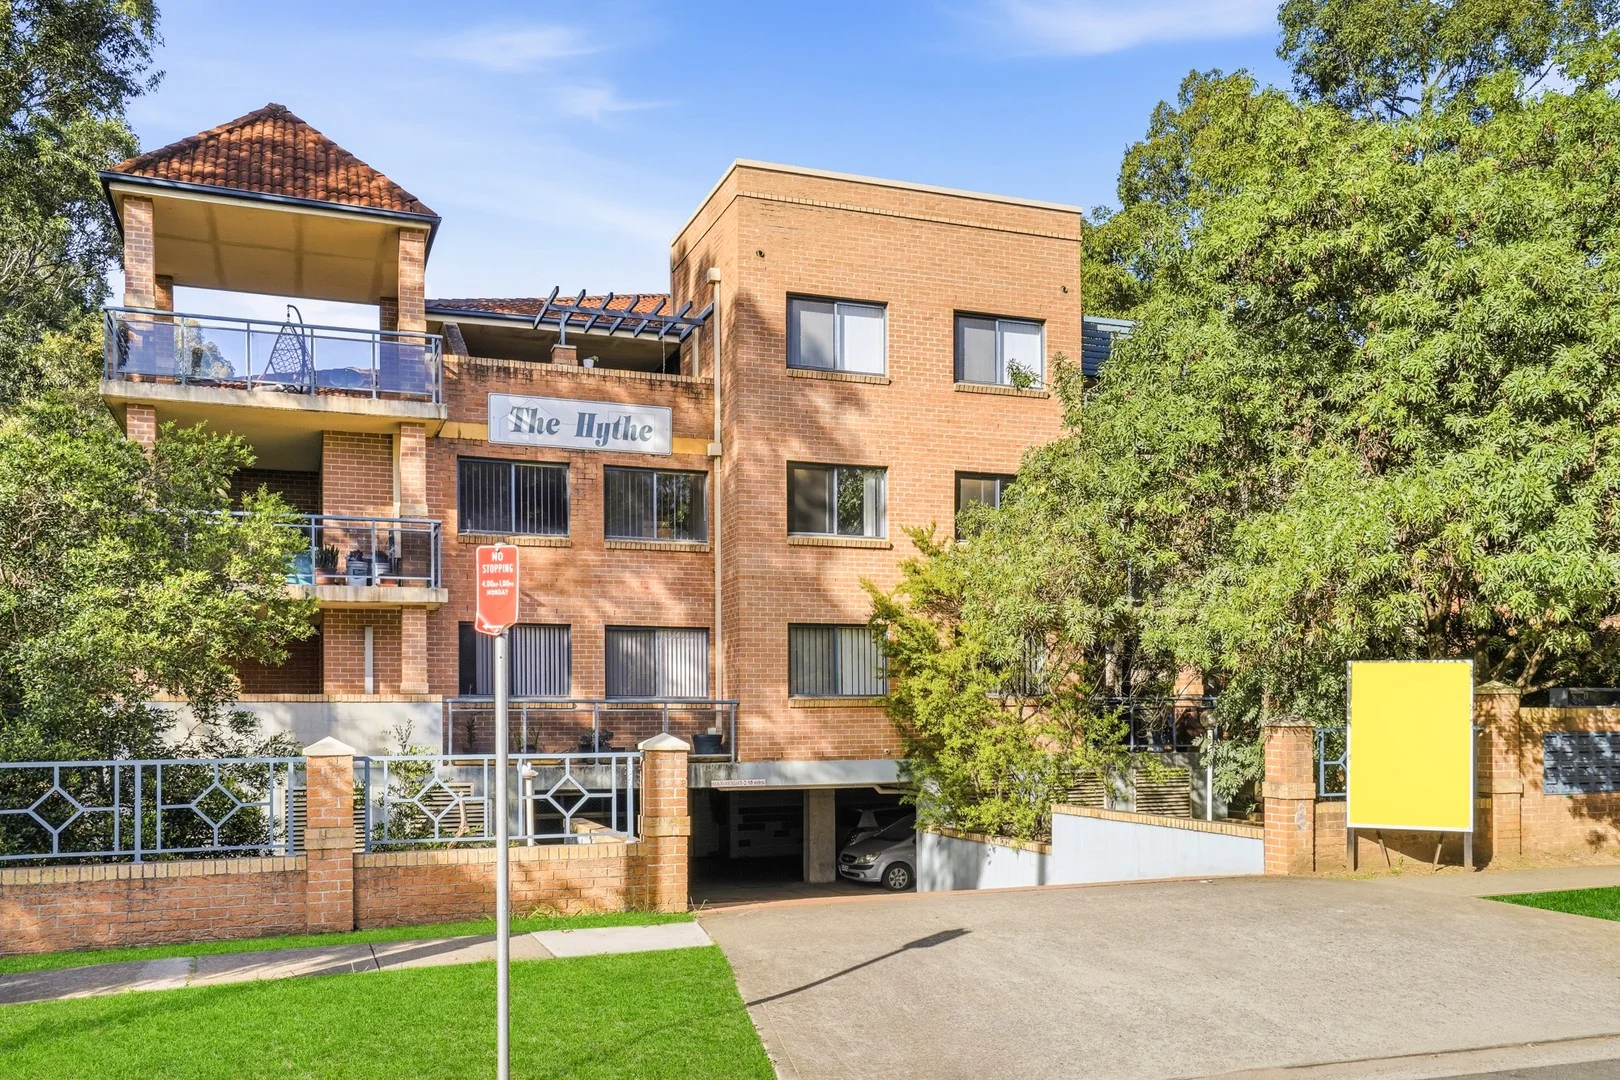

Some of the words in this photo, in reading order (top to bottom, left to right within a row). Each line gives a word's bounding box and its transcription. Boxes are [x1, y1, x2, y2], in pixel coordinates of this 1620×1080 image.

[509, 405, 561, 435] The
[574, 411, 653, 447] Hythe
[491, 552, 503, 561] NO
[482, 564, 513, 574] STOPPING
